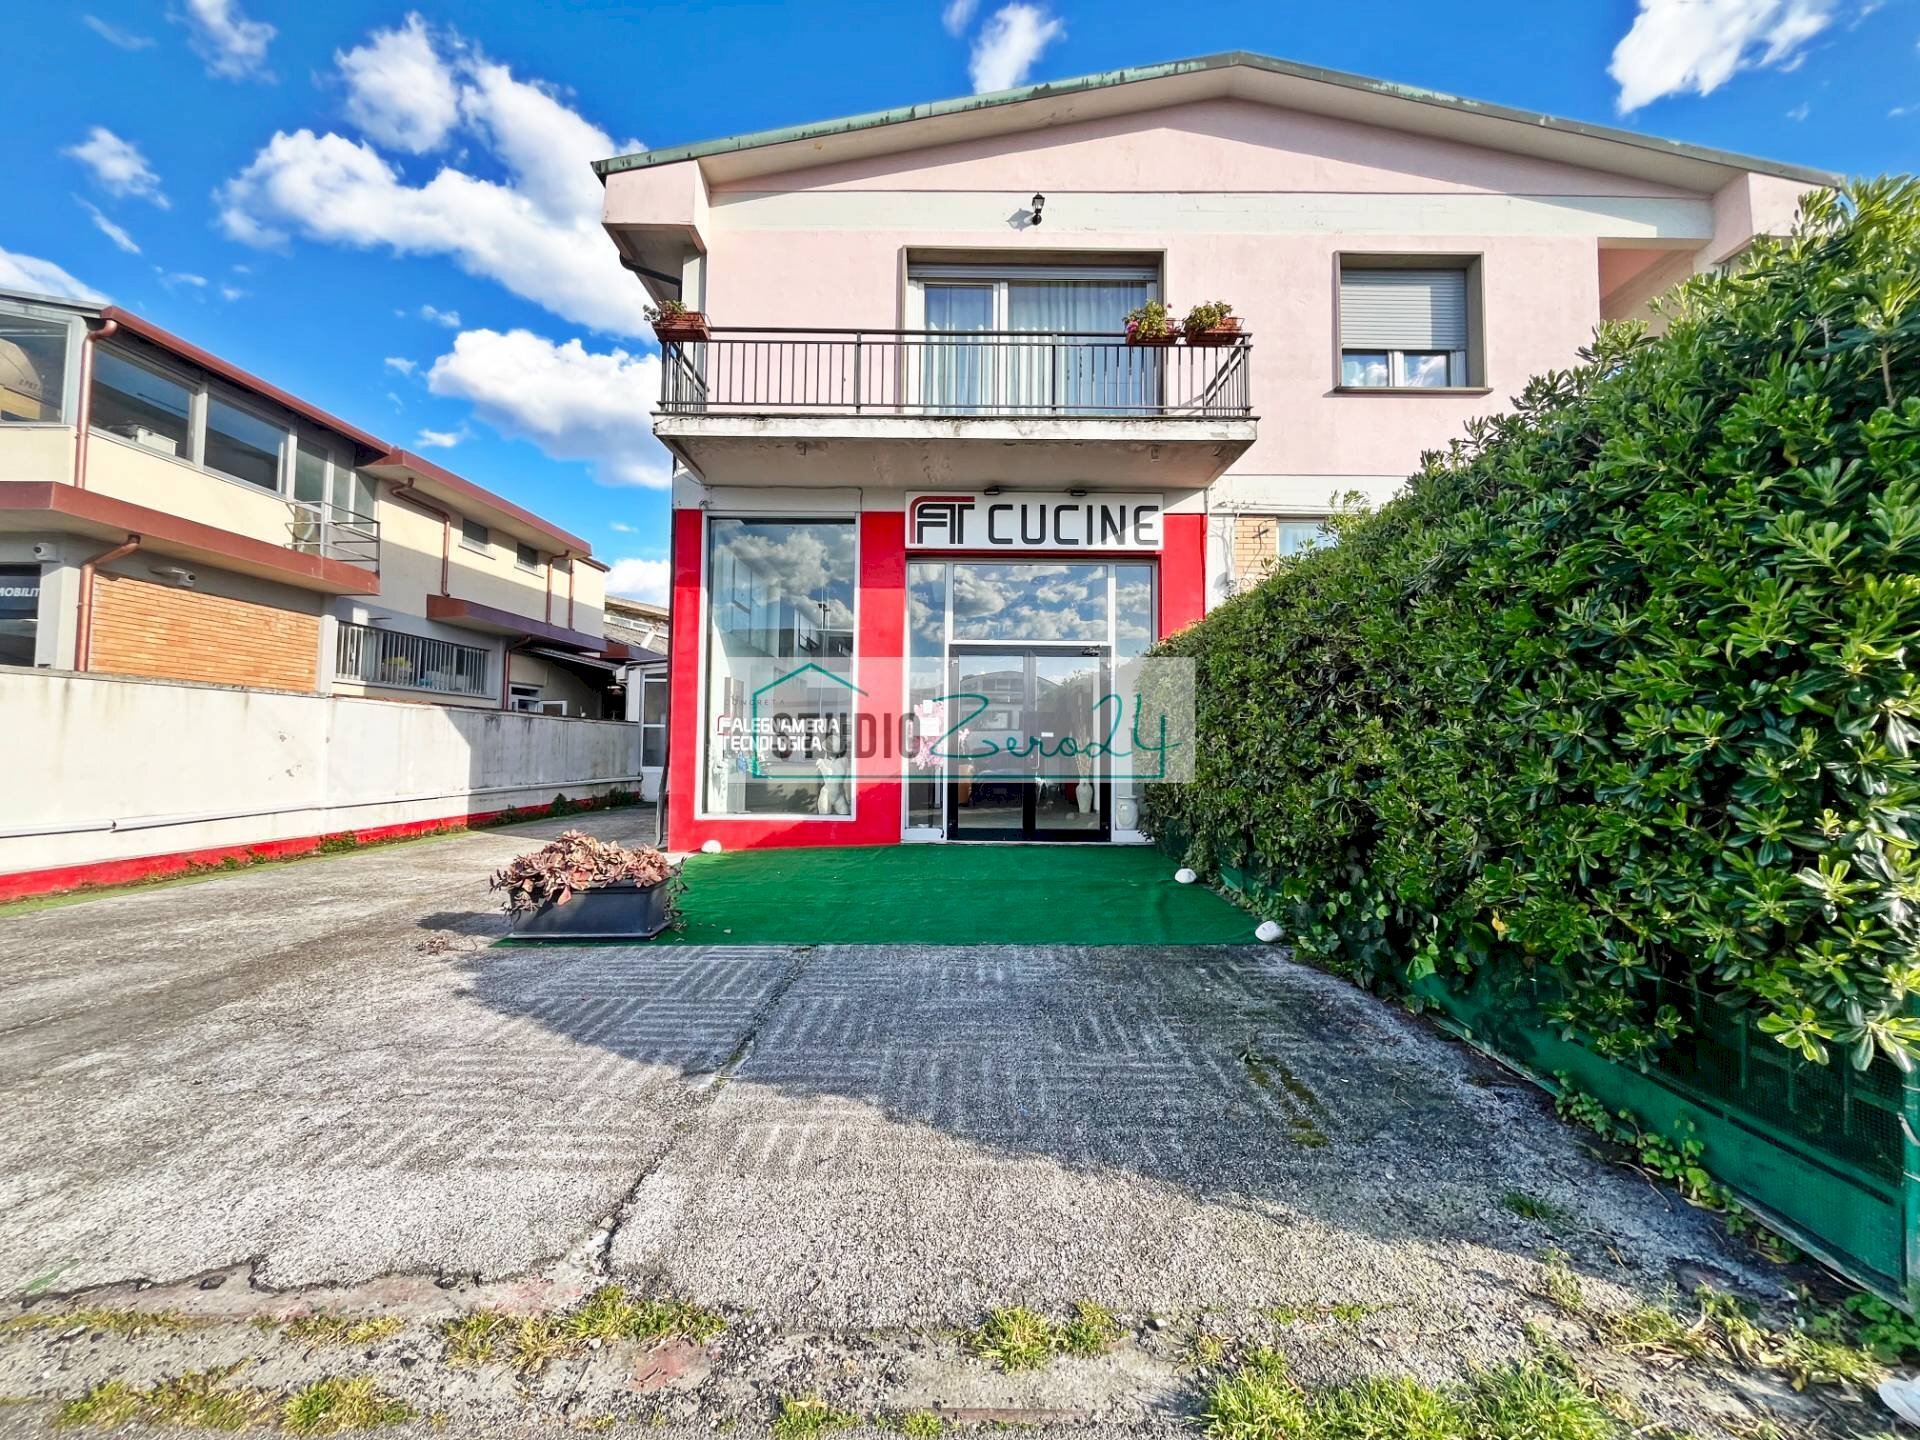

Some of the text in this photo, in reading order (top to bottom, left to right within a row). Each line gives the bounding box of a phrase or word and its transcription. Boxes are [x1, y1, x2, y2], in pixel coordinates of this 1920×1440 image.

[988, 504, 1159, 545] CUCINE
[717, 716, 840, 734] FALEGNAMERIA
[721, 735, 822, 751] TECNOLOGICA
